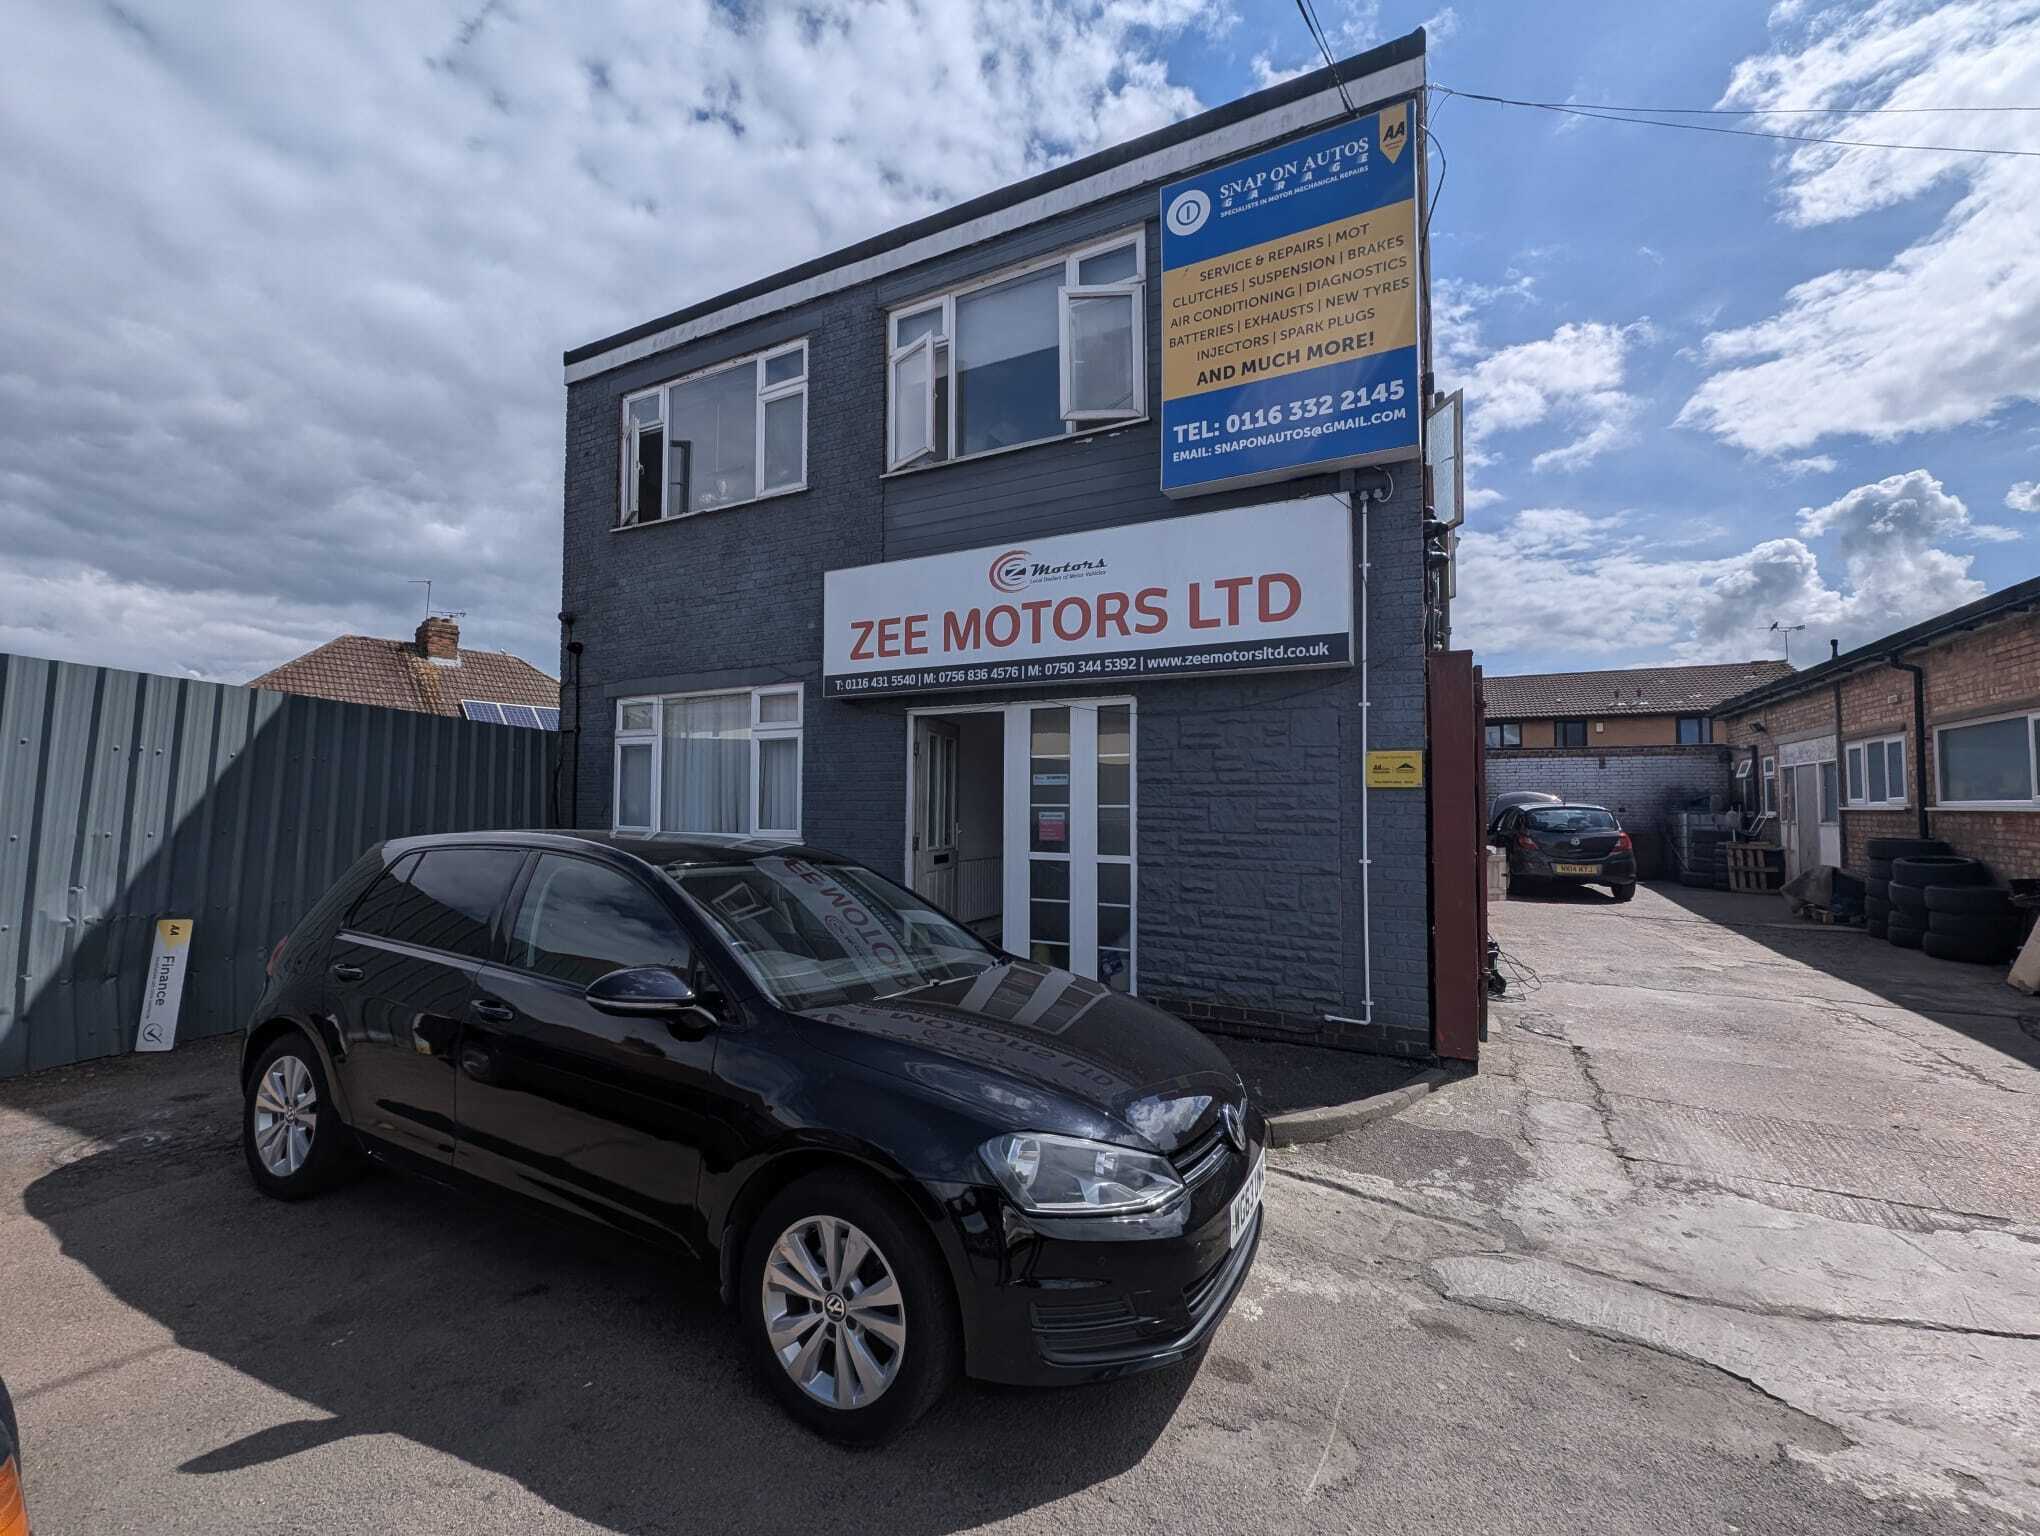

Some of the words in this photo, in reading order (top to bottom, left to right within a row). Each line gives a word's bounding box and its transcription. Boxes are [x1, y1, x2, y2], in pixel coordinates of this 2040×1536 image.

[1383, 120, 1404, 142] AA
[1220, 172, 1266, 199] SNAP
[1270, 161, 1298, 181] ON
[1302, 138, 1368, 172] AUTOS
[1220, 201, 1258, 218] SPECIALISTS
[1268, 190, 1292, 203] MOTOR
[1294, 176, 1339, 193] MECHANICAL
[1340, 165, 1368, 180] REPAIRS
[1172, 283, 1238, 308] CLUTCHES
[1249, 256, 1335, 288] SUSPENSION
[1348, 235, 1405, 260] BRAKES
[1200, 257, 1252, 282] SERVICE
[1255, 255, 1264, 266] &
[1268, 237, 1324, 264] REPAIRS
[1335, 223, 1370, 244] MOT
[1169, 324, 1234, 348] BATTERIES
[1244, 303, 1314, 329] EXHAUSTS
[1325, 291, 1360, 308] NEW
[1362, 277, 1410, 299] TYRES
[1170, 313, 1190, 329] AIR
[1193, 287, 1295, 322] CONDITIONING
[1306, 256, 1407, 292] DIAGNOSTICS
[1196, 365, 1235, 386] AND
[1241, 350, 1300, 376] MUCH
[1306, 331, 1375, 361] MORE!
[1197, 334, 1269, 361] INJECTORS
[1280, 320, 1324, 341] SPARK
[1328, 307, 1375, 328] PLUGS
[1173, 420, 1220, 444] TEL:
[1226, 405, 1282, 433] 0116
[1289, 395, 1333, 421] 332
[1340, 379, 1405, 411] 2145
[1173, 445, 1211, 463] EMAIL:
[1214, 407, 1406, 454] SNAPONAUTOS@GMAIL.COM
[1030, 558, 1108, 576] Motors
[849, 613, 928, 661] ZEE
[942, 587, 1169, 653] MOTORS
[1188, 572, 1302, 630] LTD
[835, 680, 843, 691] T:
[845, 678, 869, 690] 0116
[870, 677, 889, 688] 431
[891, 675, 916, 687] 5540
[923, 672, 936, 684] M:
[938, 670, 965, 683] 0756
[967, 668, 988, 681] 836
[990, 666, 1019, 680] 4576
[1027, 664, 1042, 677] M:
[1045, 662, 1075, 675] 0750
[1077, 660, 1101, 673] 344
[1104, 657, 1137, 671] 5392
[1147, 642, 1329, 669] www.zeemotorsltd.co.uk
[170, 924, 180, 936] AA
[155, 956, 175, 1006] Finance
